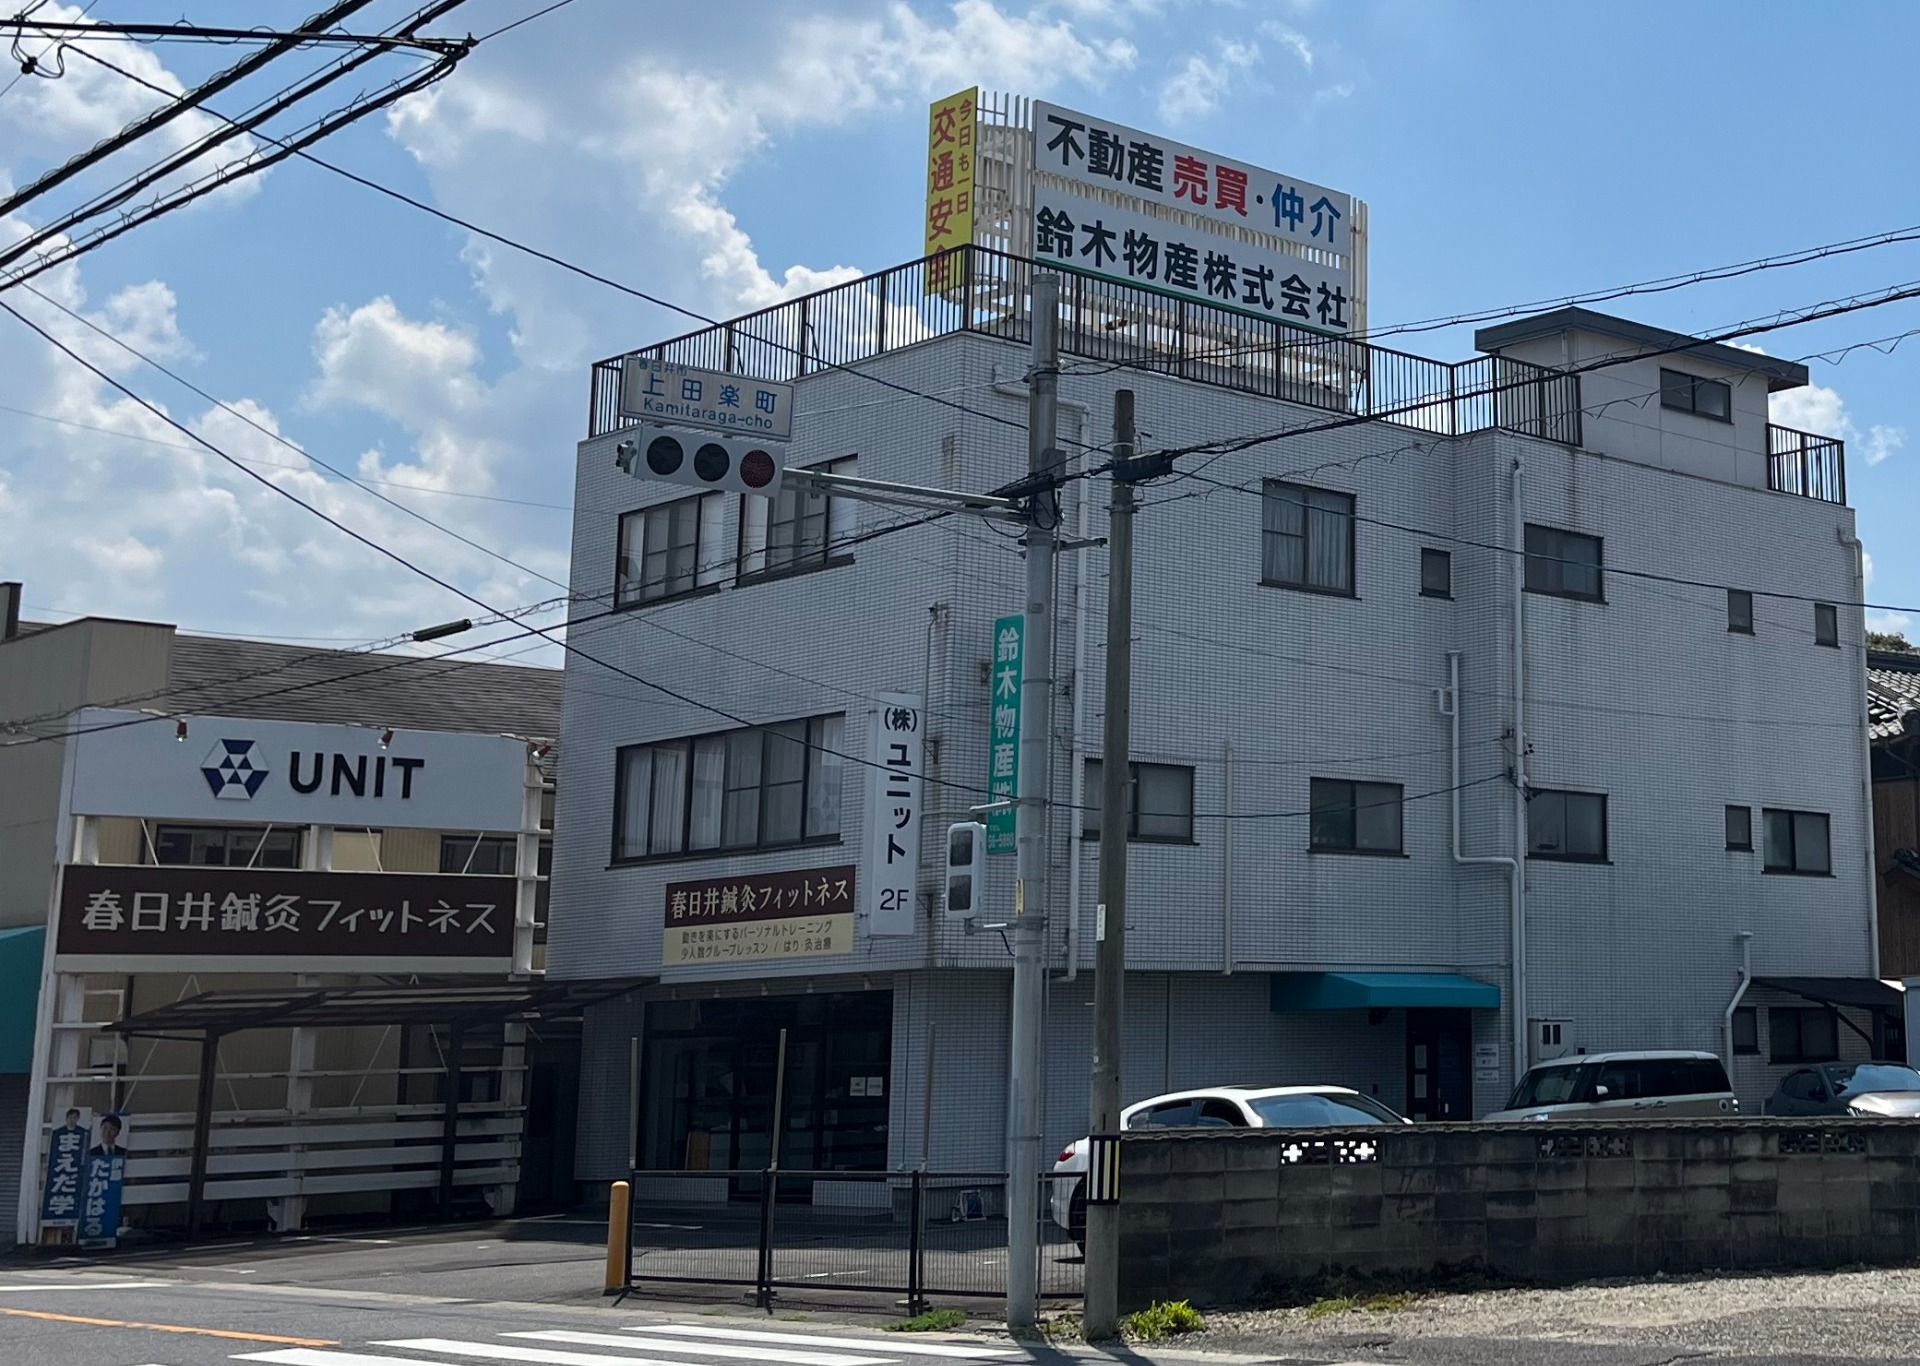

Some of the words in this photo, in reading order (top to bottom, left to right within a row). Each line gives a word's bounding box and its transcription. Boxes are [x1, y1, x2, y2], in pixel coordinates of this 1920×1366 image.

[957, 98, 972, 215] 今日も一日
[1036, 205, 1348, 329] 鈴木物産株式会社
[642, 373, 777, 414] 上田楽町
[644, 397, 773, 429] Kamitaraga-cho
[288, 751, 425, 799] UNIT
[82, 889, 496, 935] 春日井鍼灸フィットネス
[670, 876, 849, 919] 春日井鍼灸フィットネス
[880, 888, 909, 911] 2F
[48, 1132, 81, 1215] まえだ学
[85, 1158, 110, 1236] たかはる
